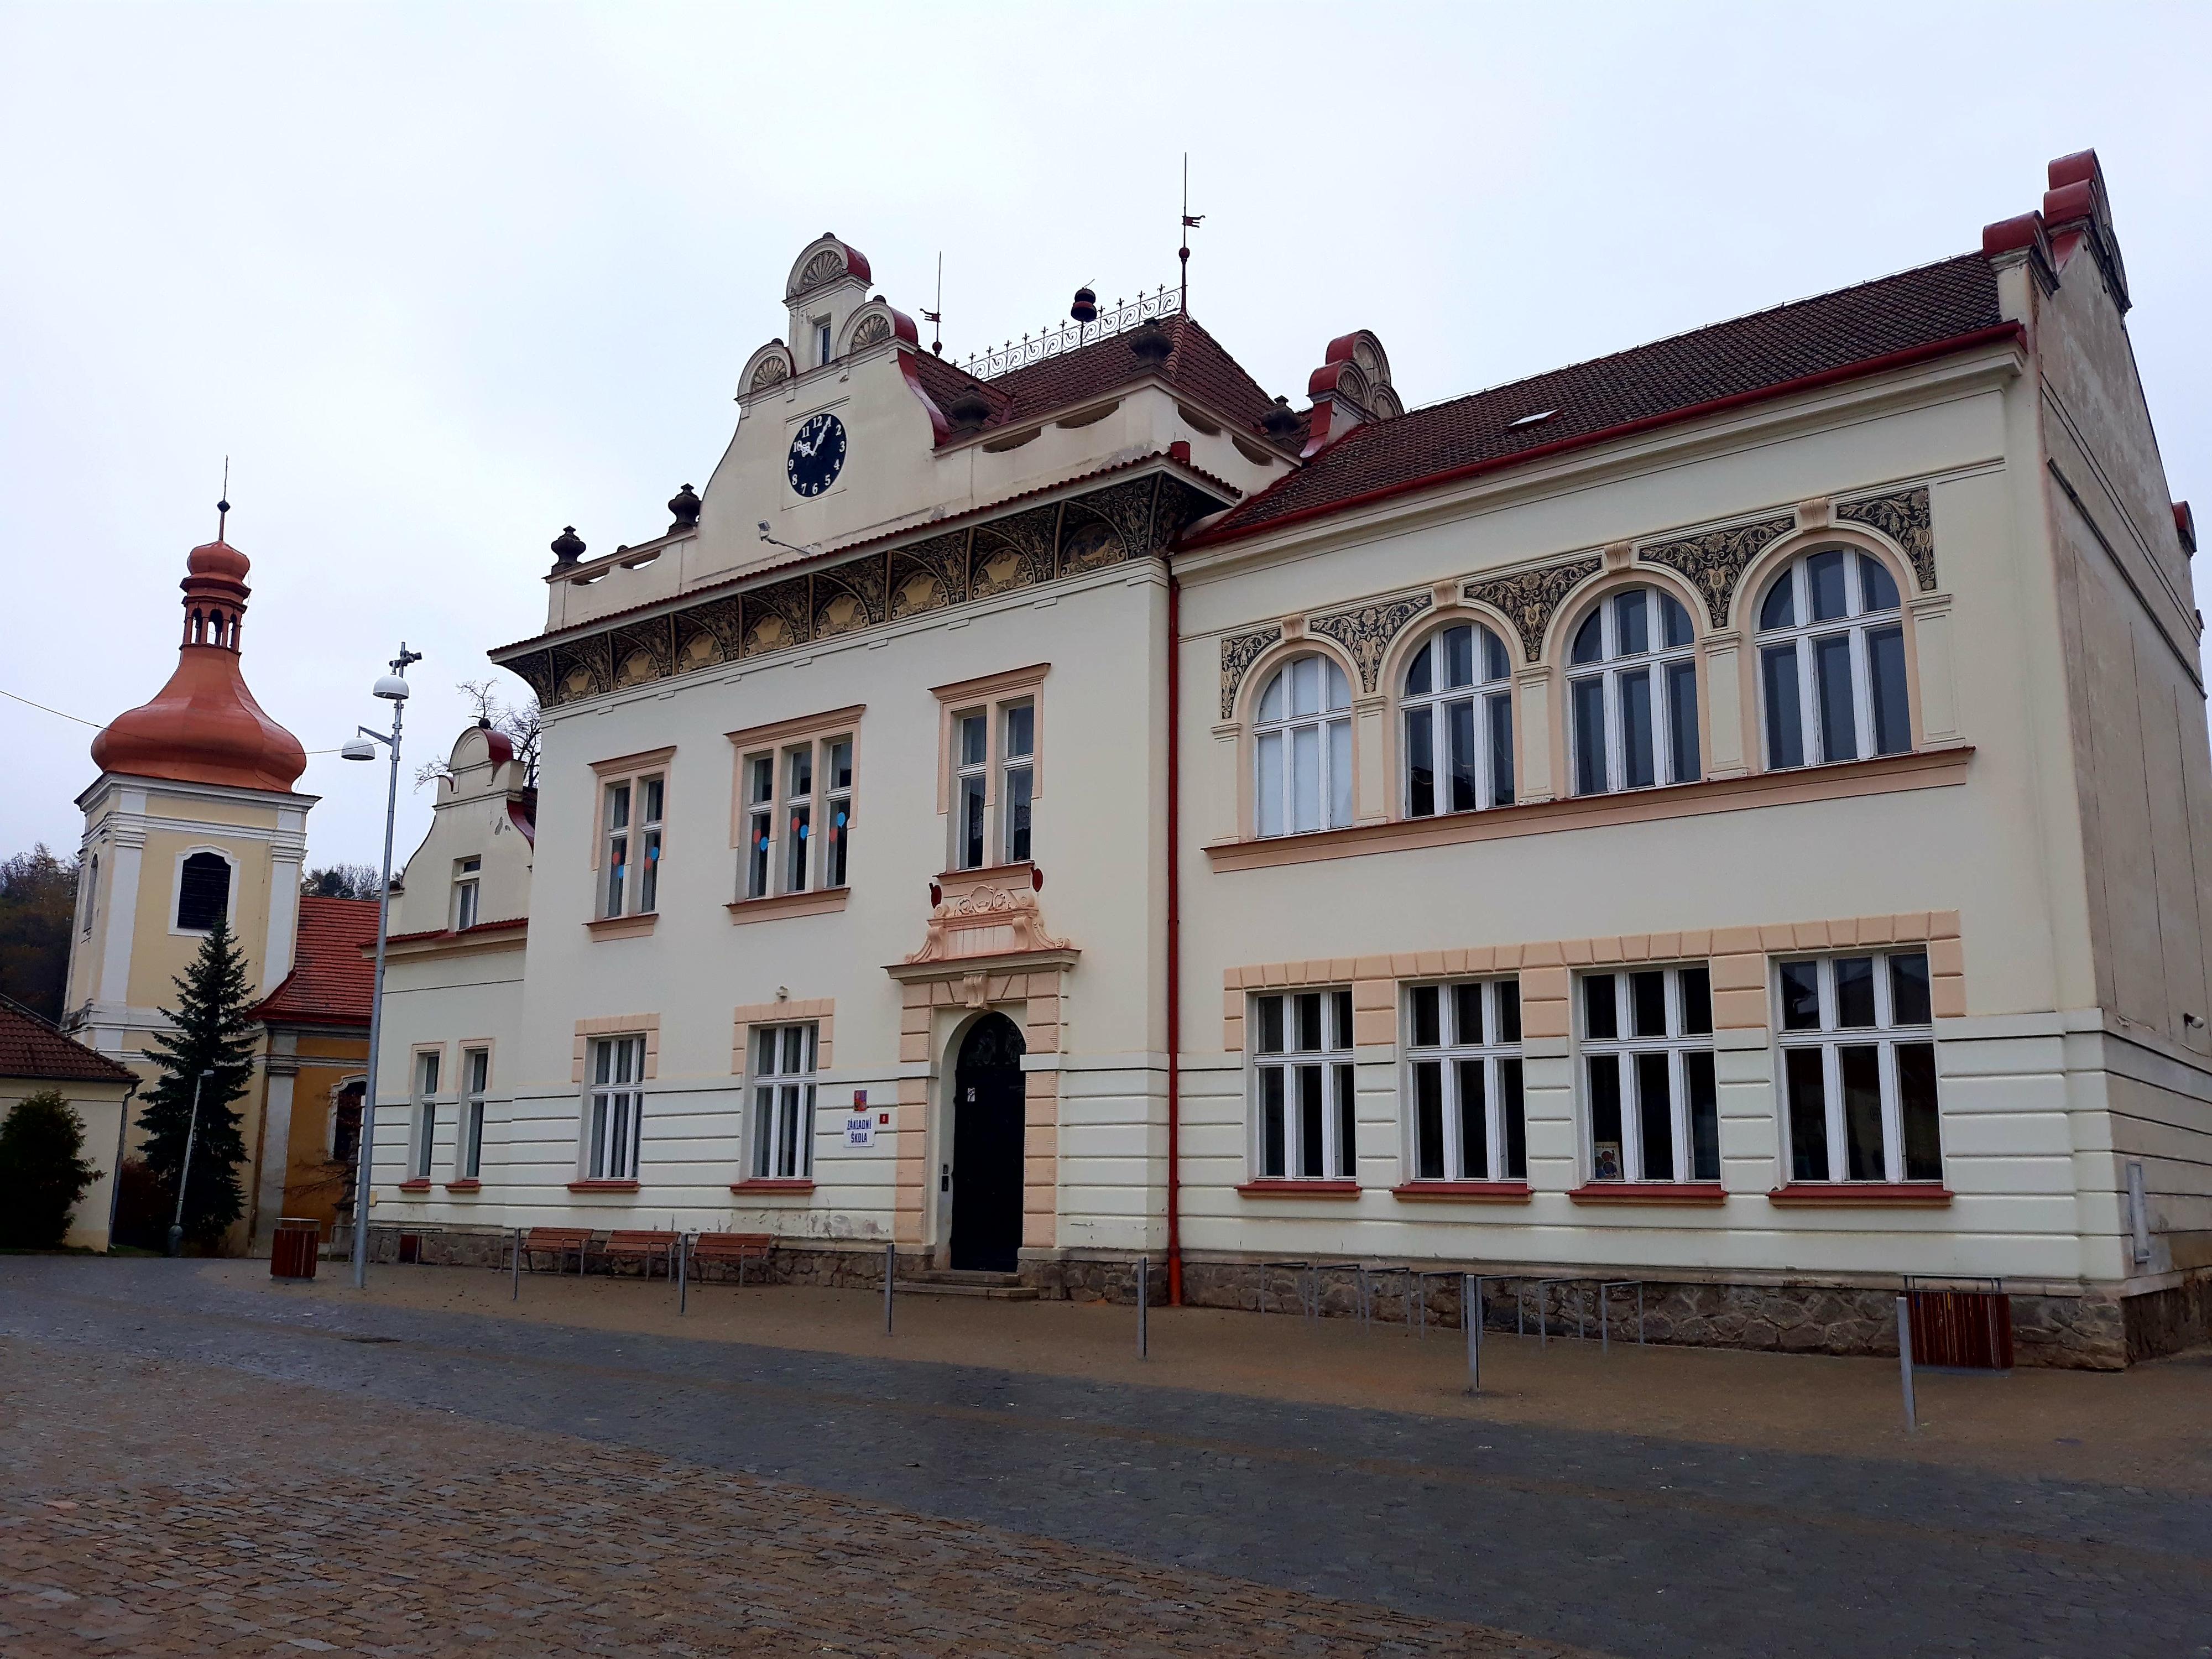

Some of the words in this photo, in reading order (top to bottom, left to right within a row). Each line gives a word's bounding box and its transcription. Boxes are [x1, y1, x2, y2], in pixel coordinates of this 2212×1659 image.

[813, 416, 822, 428] 12
[802, 426, 810, 438] 11
[836, 424, 842, 436] 2
[839, 441, 845, 452] 3
[789, 460, 794, 470] 9
[833, 459, 840, 470] 4
[792, 474, 797, 485] 8
[825, 474, 831, 486] 5
[801, 483, 807, 494] 7
[812, 483, 818, 494] 6
[847, 1117, 872, 1130] ZÁKLADNÍ
[851, 1131, 867, 1143] ŠKOLA
